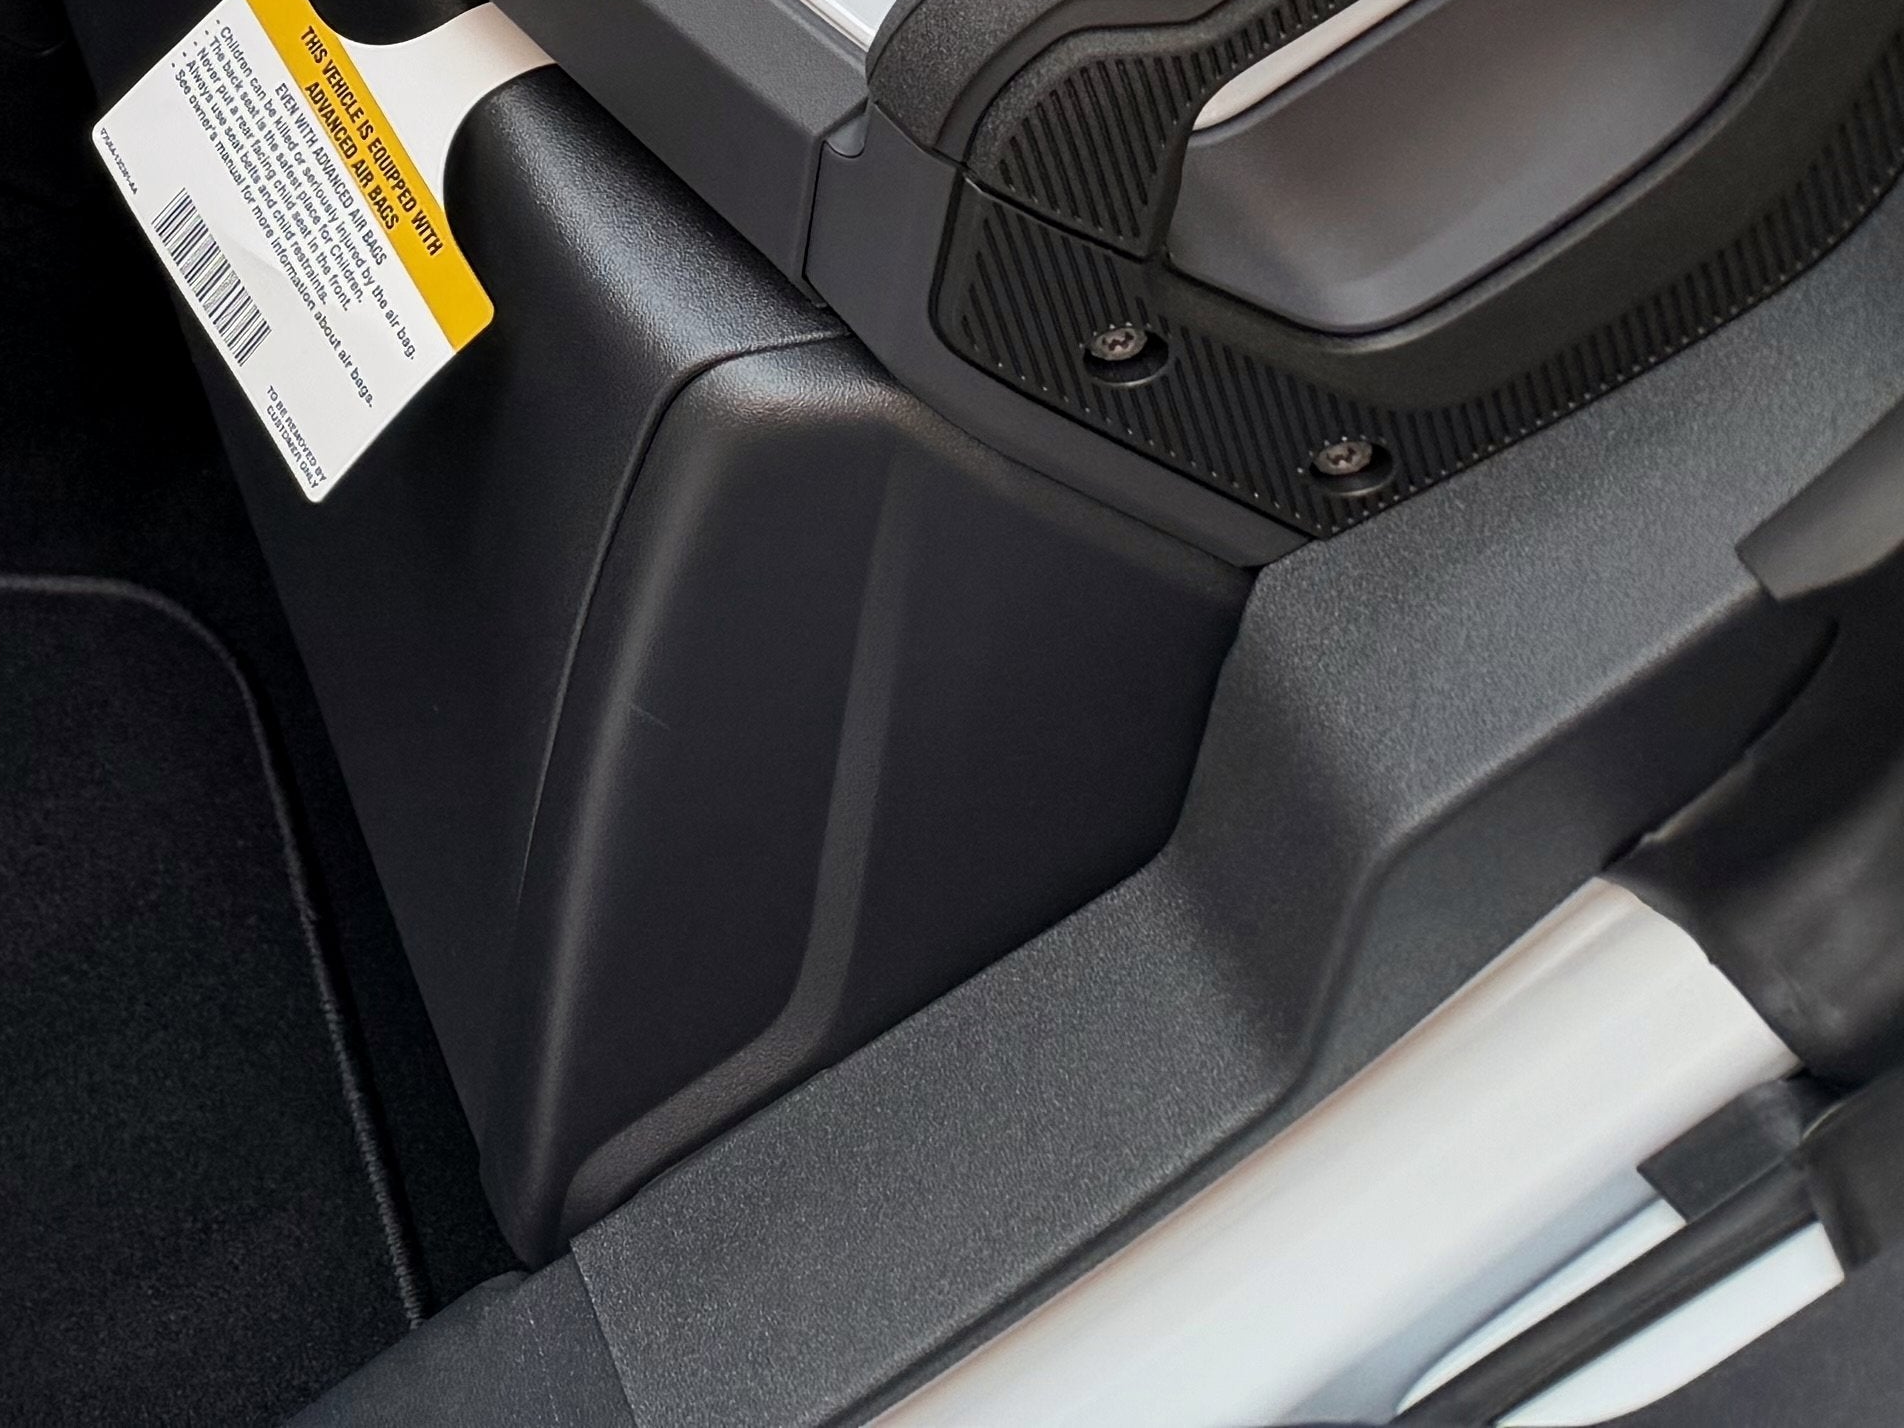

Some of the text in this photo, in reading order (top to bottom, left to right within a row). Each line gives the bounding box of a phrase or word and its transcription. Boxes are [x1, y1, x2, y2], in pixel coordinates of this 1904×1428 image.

[175, 68, 373, 408] See owner's manual for more information about air bags.
[185, 59, 328, 306] Always use seat belts and child restraints.
[196, 47, 351, 312] Never put a rear facing child seat in the front.
[209, 35, 364, 304] The back seat is the safest place for Children.
[220, 26, 416, 360] Children can be killed or seriously injured by the air bag.
[274, 82, 388, 266] EVEN WITH ADVANCED AIR BAGS
[300, 25, 444, 256] THIS VEHICLE IS EQUIPPED WITH
[304, 81, 400, 230] ADVANCED AIR BAGS
